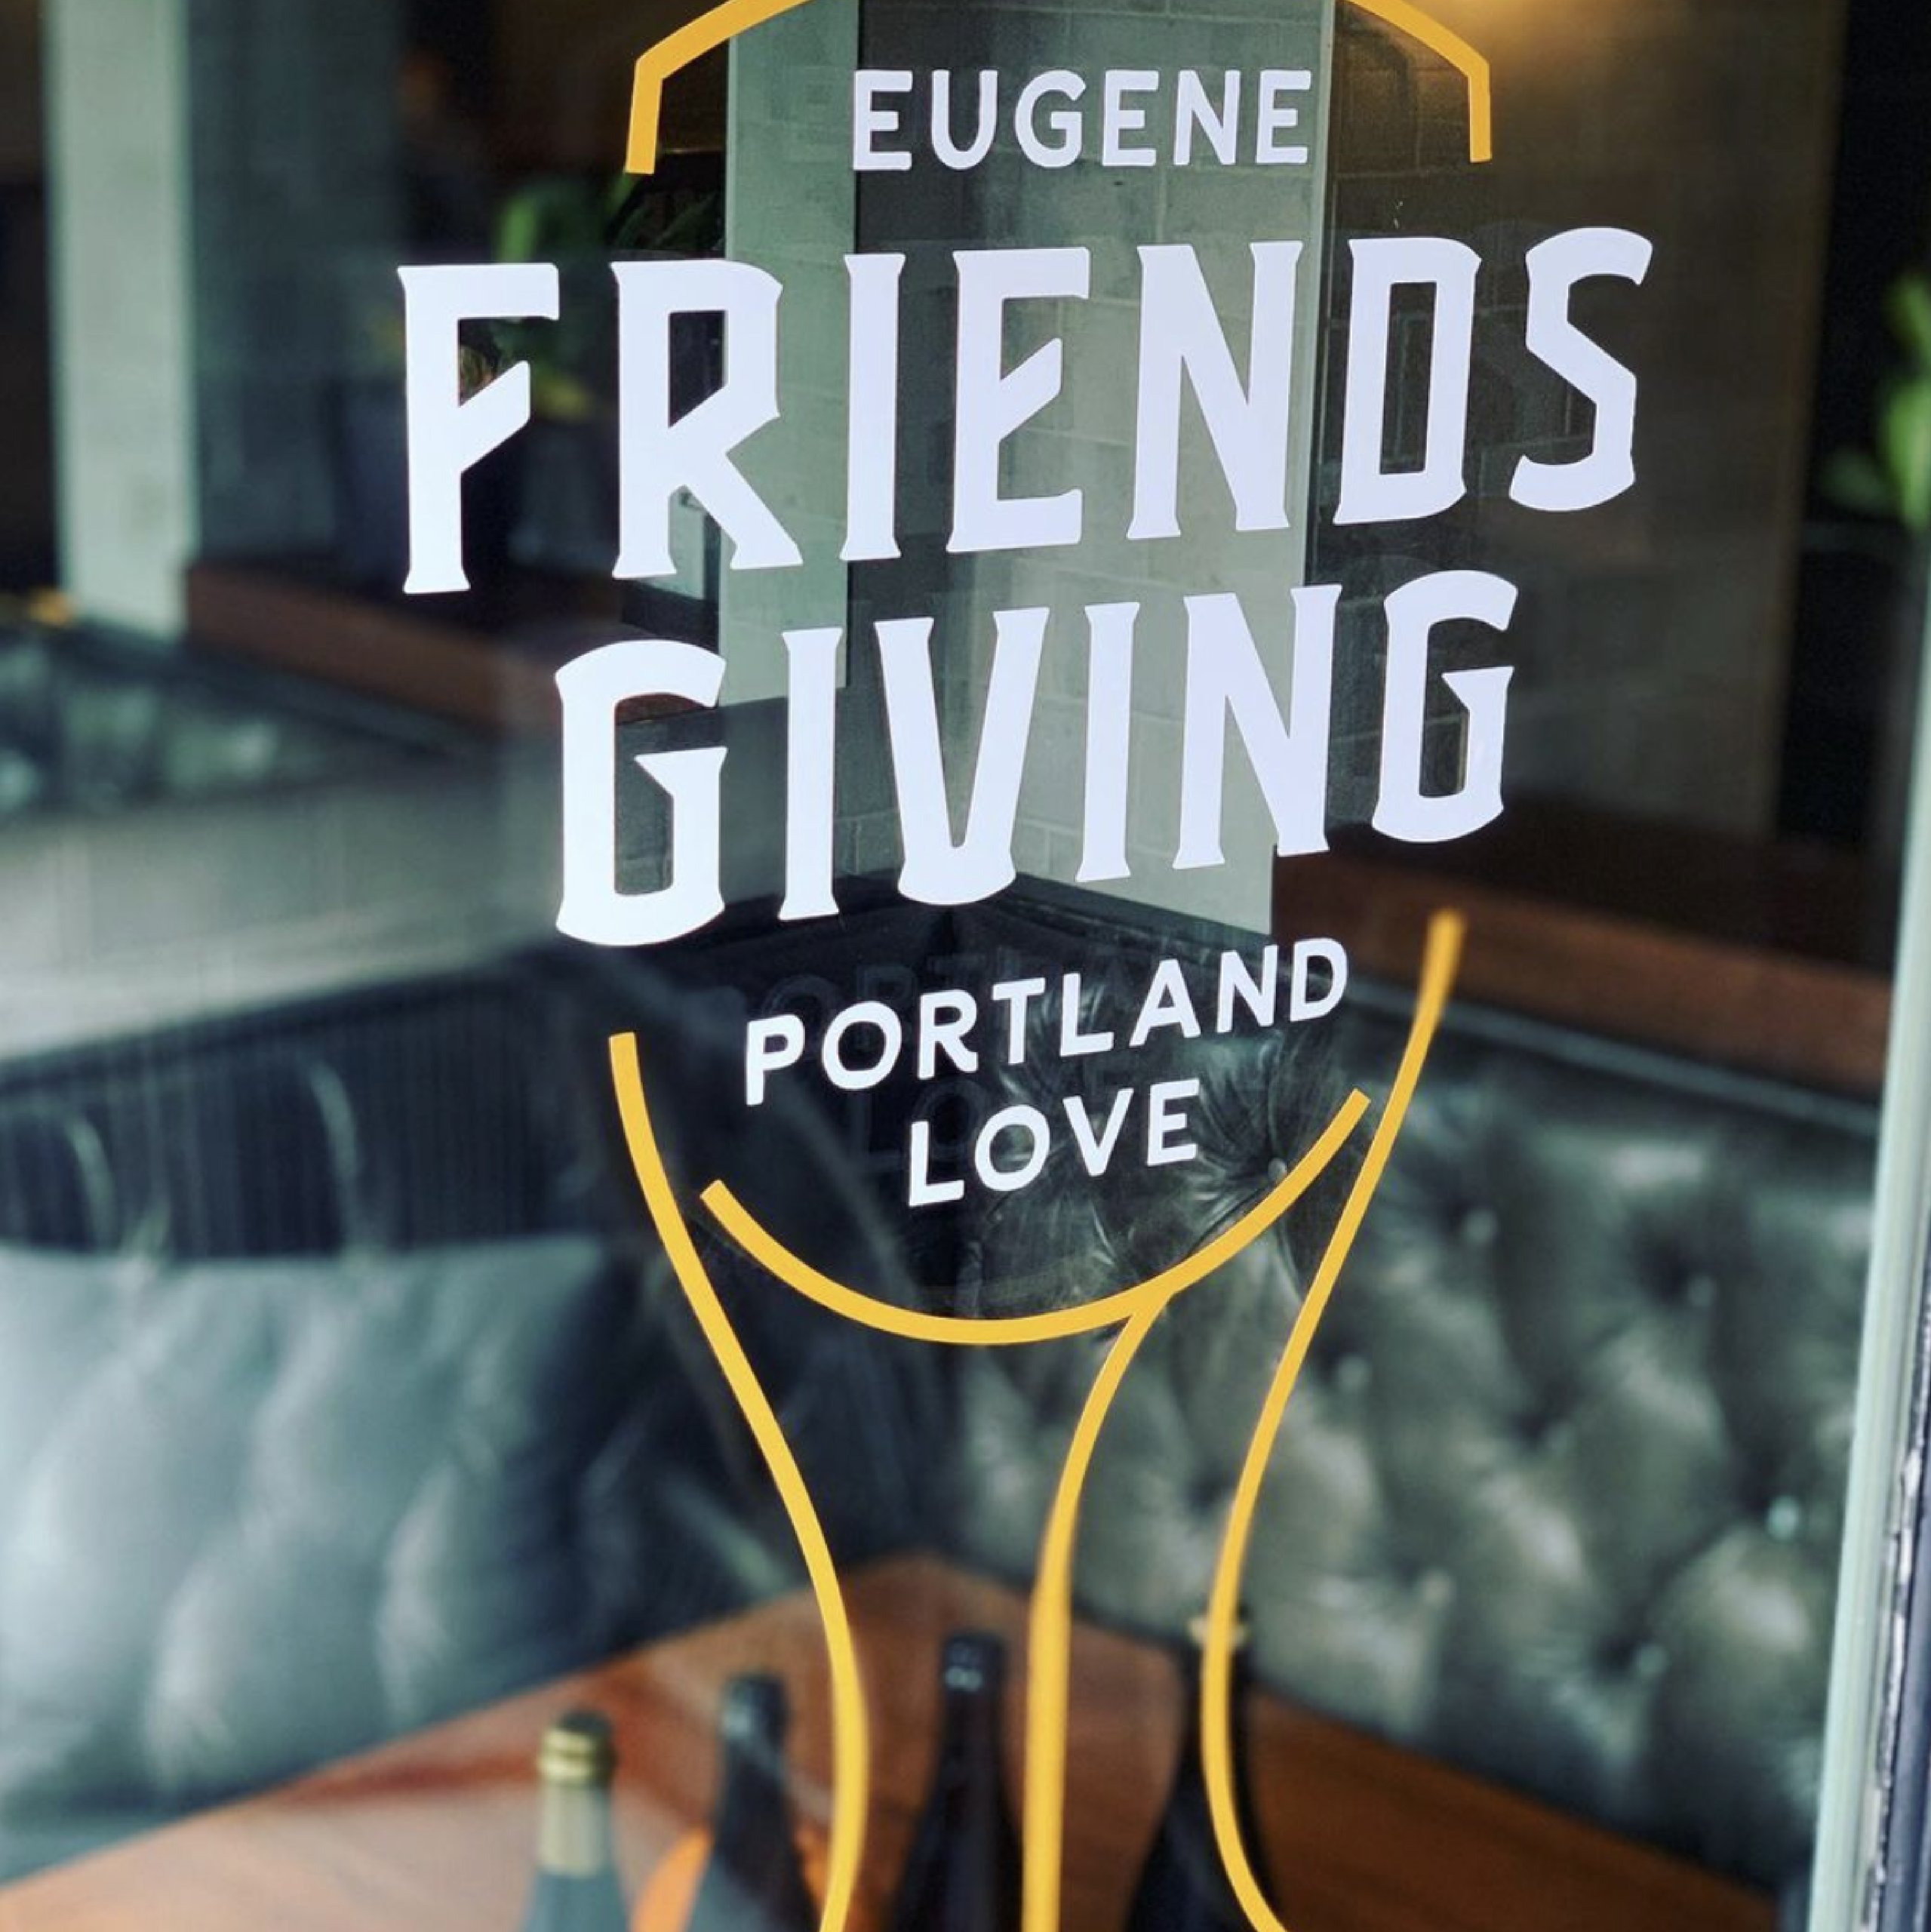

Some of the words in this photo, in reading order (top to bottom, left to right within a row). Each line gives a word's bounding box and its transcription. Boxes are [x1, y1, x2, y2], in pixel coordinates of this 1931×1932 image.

[852, 69, 1313, 171] EUGENE
[396, 226, 1653, 595] FRIENDS
[554, 569, 1517, 947] GIVING
[744, 937, 1349, 1106] PORTLAND
[907, 1078, 1201, 1208] LOVE
